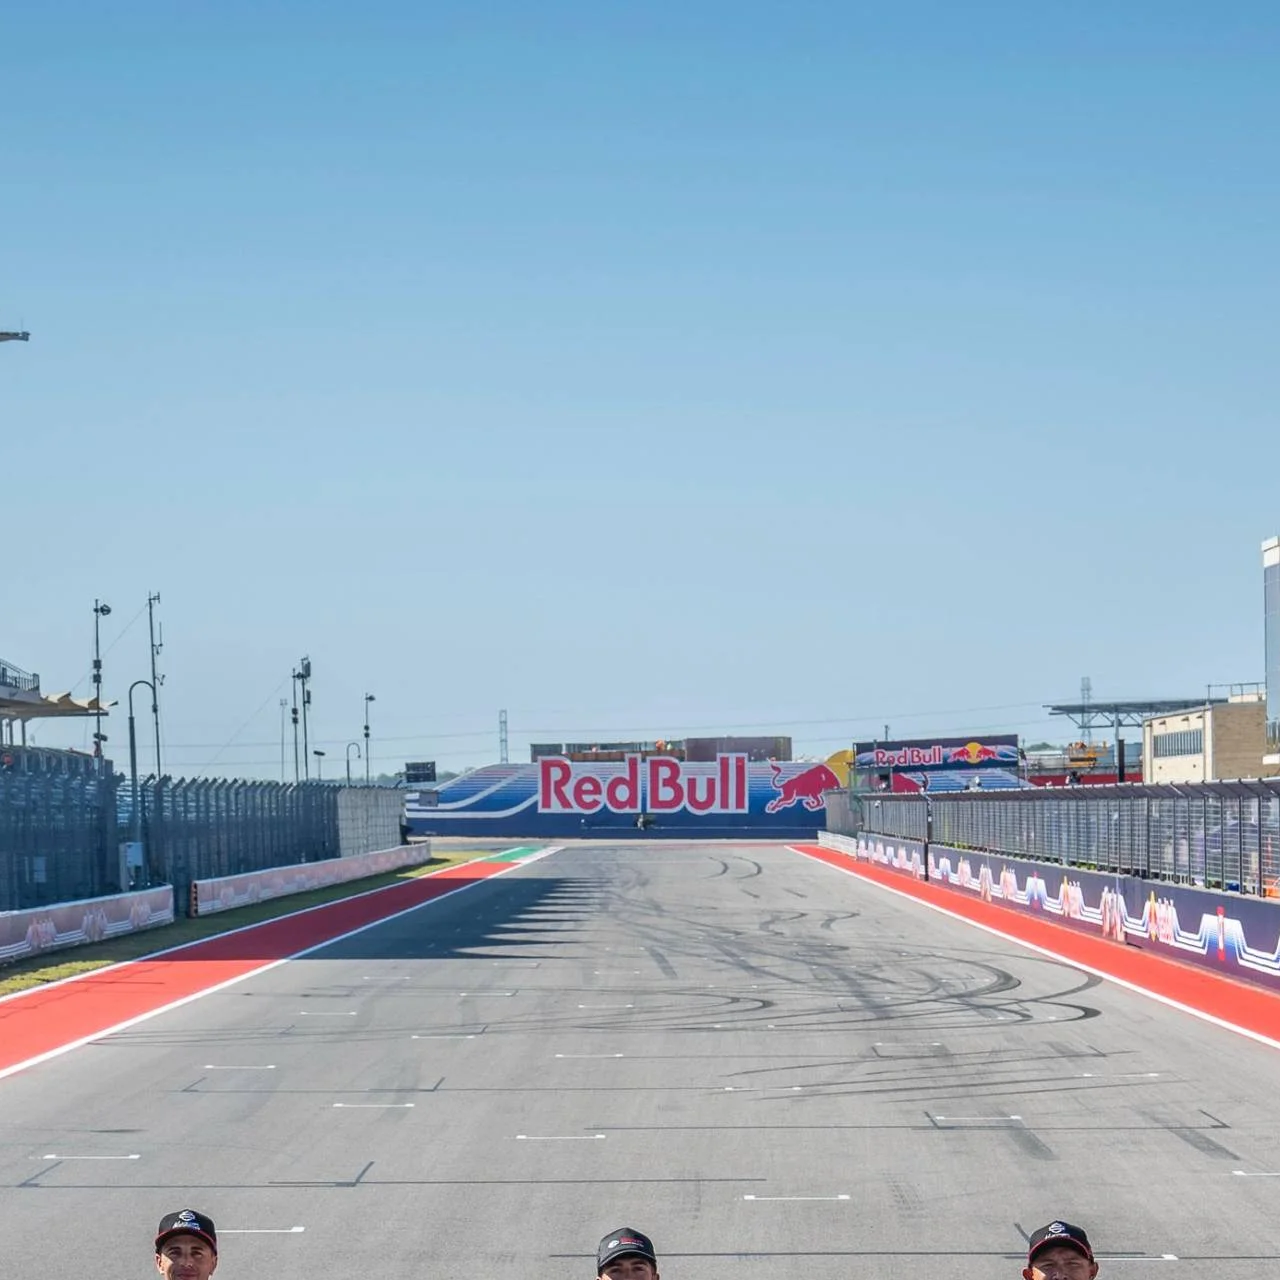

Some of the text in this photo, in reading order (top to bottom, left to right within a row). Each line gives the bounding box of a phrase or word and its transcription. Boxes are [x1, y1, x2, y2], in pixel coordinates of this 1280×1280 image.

[875, 746, 943, 767] Red Bull
[540, 756, 746, 811] Red Bull
